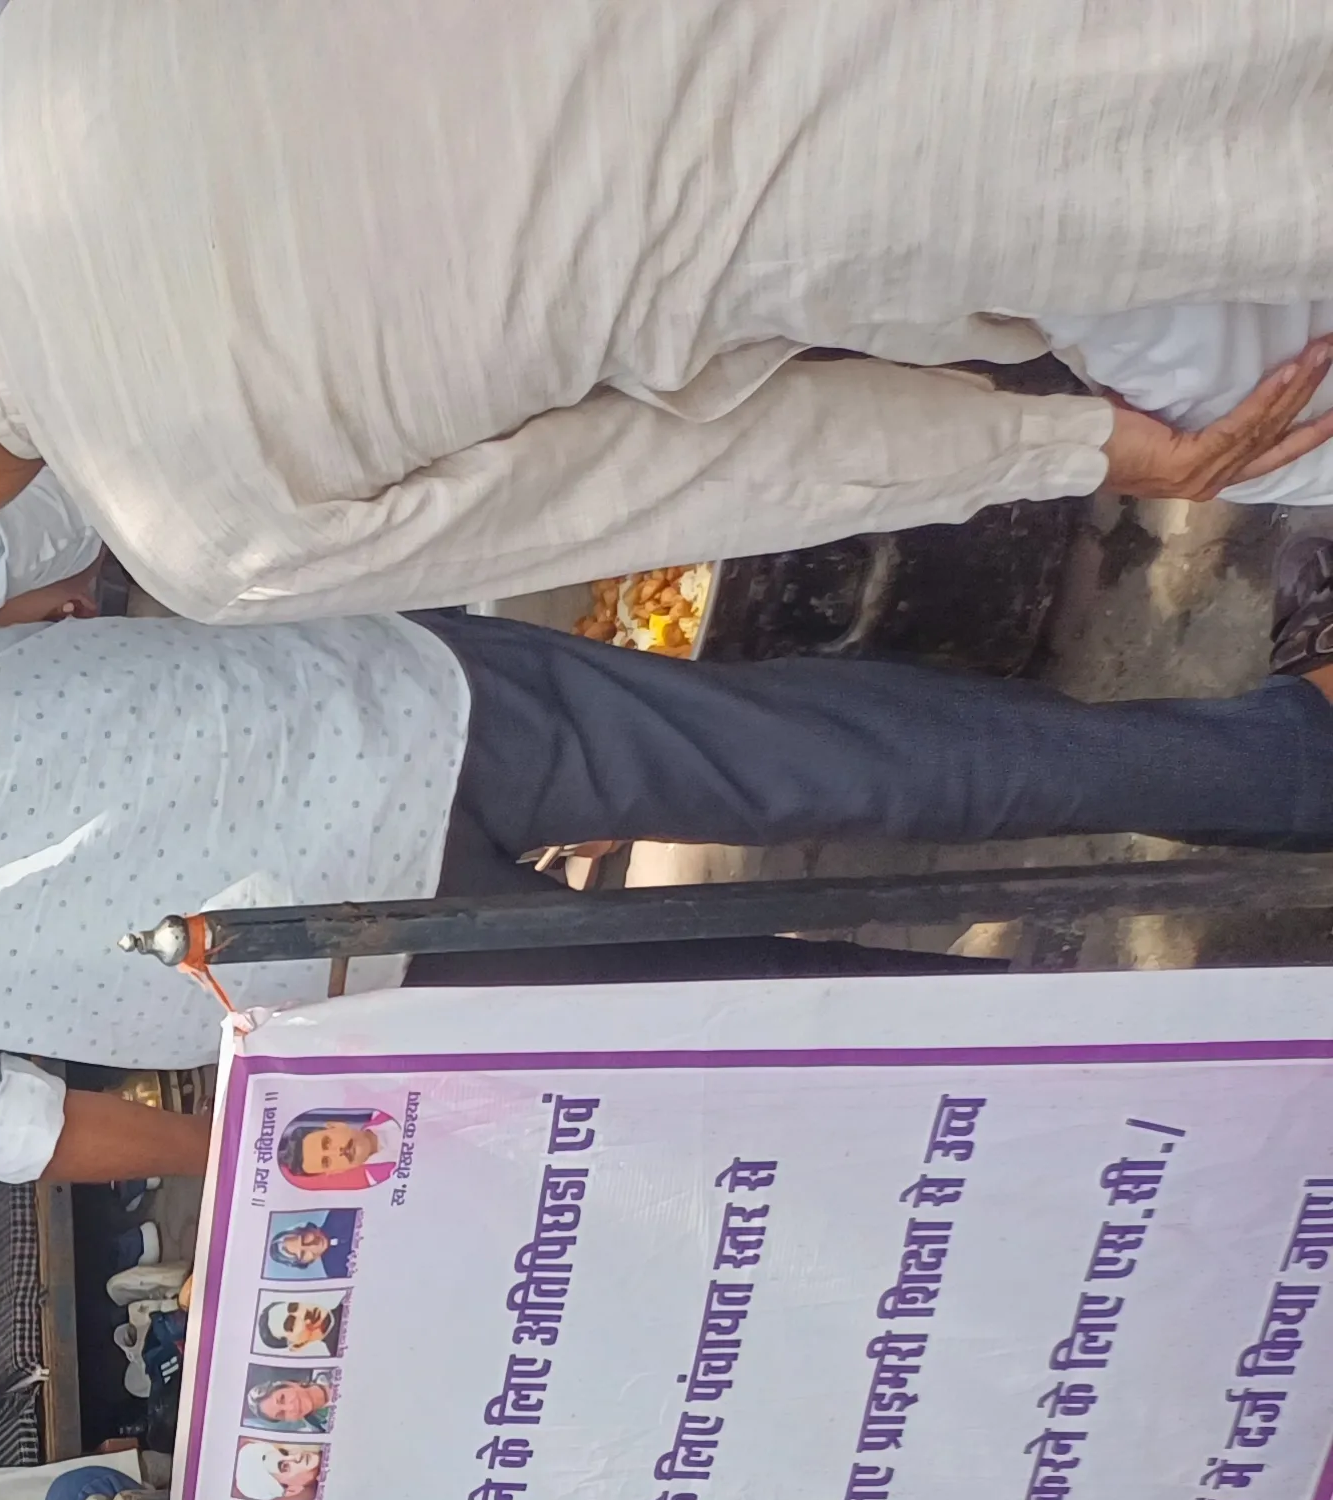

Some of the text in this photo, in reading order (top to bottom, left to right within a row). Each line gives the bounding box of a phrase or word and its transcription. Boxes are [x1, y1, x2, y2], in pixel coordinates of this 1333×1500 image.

[251, 1106, 279, 1194] जय संविधान
[390, 1091, 421, 1206] स्व. शेखर कश्यप
[541, 1092, 601, 1154] एवं
[923, 1092, 987, 1164] उच्च
[714, 1156, 779, 1194] से
[899, 1173, 965, 1208] से
[505, 1164, 590, 1346] अतिपिछडा
[711, 1201, 771, 1270] स्तर
[876, 1217, 954, 1320] शिक्षा
[676, 1279, 755, 1403] पंचायत
[1048, 1292, 1125, 1371] लिए
[1235, 1282, 1322, 1378] किया
[483, 1354, 553, 1426] लिए
[855, 1330, 929, 1453] प्राइमरी
[1035, 1380, 1097, 1419] के
[1224, 1387, 1289, 1449] दर्ज
[476, 1435, 535, 1469] के
[652, 1411, 725, 1481] लिए
[1199, 1457, 1265, 1490] में
